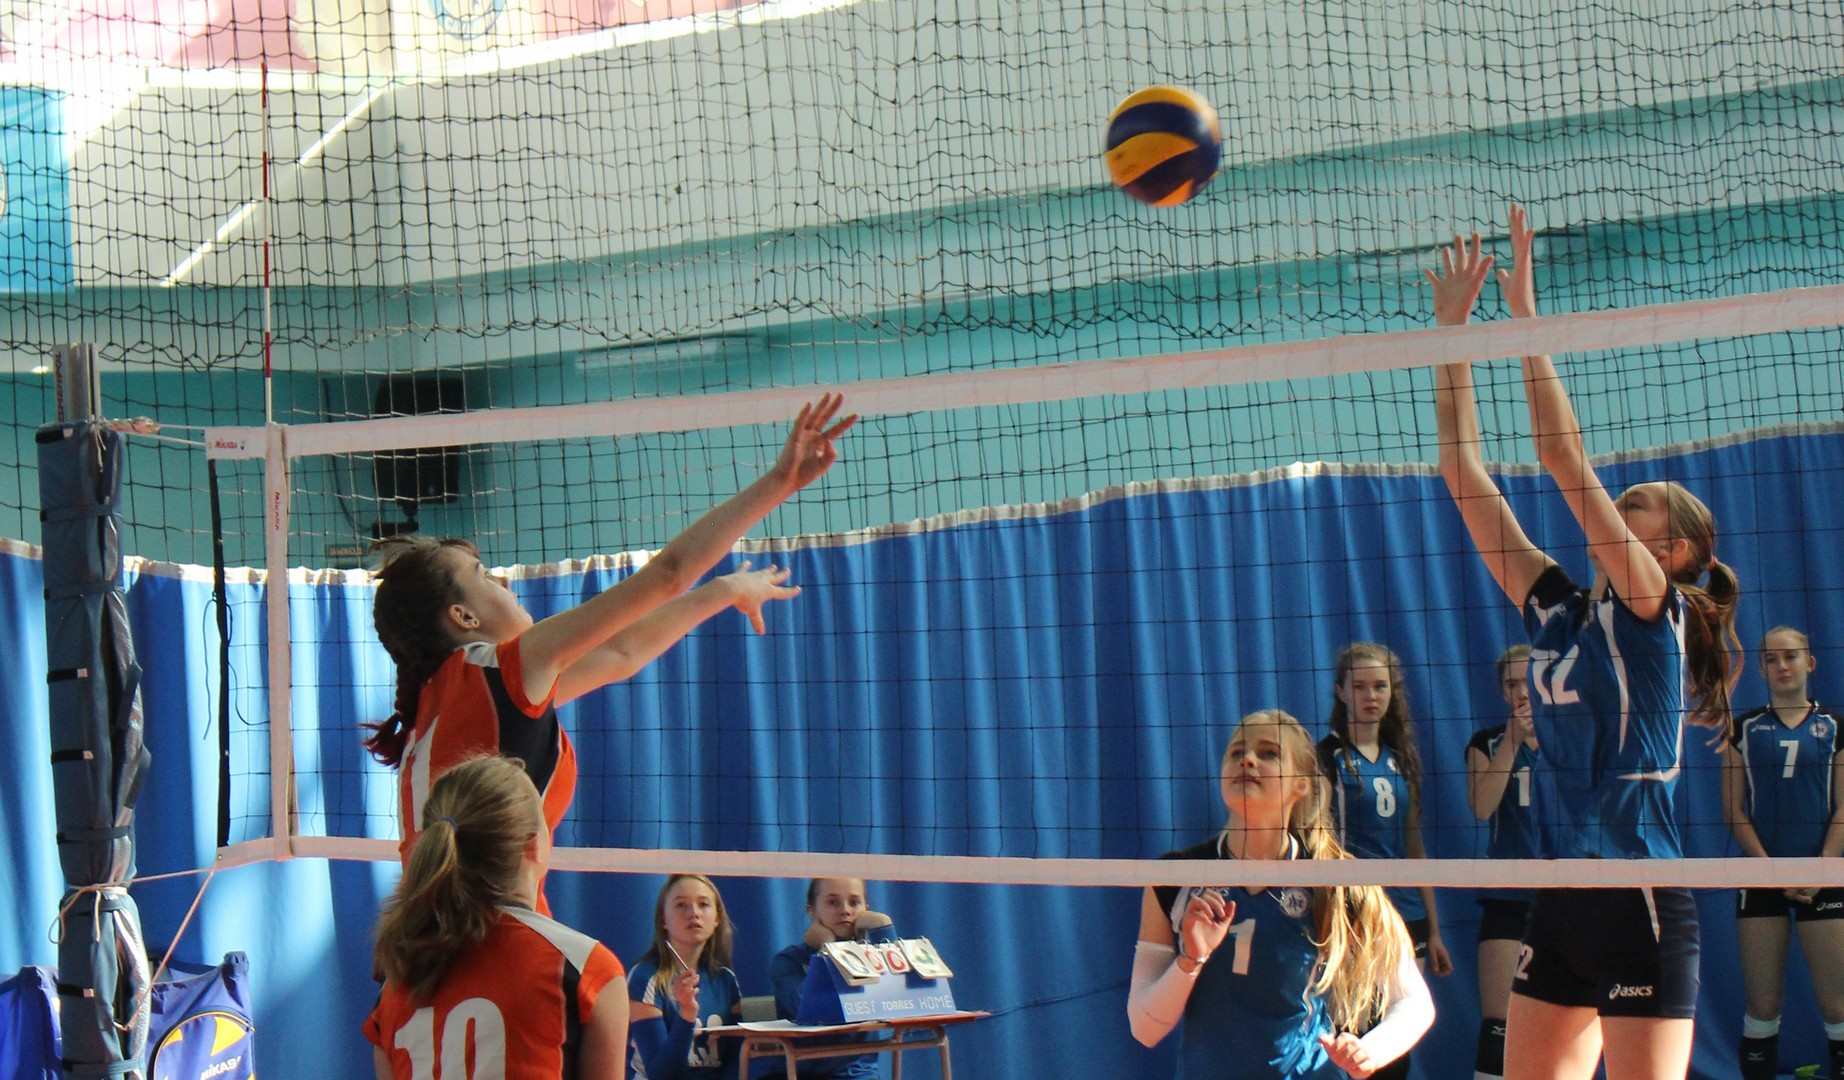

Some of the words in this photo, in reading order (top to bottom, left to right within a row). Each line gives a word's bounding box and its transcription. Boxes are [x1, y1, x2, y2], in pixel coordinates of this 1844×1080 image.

[1530, 644, 1580, 705] 12
[1779, 740, 1799, 778] 7
[1372, 776, 1396, 818] 8
[1229, 918, 1256, 976] 1
[843, 1001, 877, 1016] GUEST
[881, 999, 915, 1012] TORRES
[918, 994, 954, 1010] HOME
